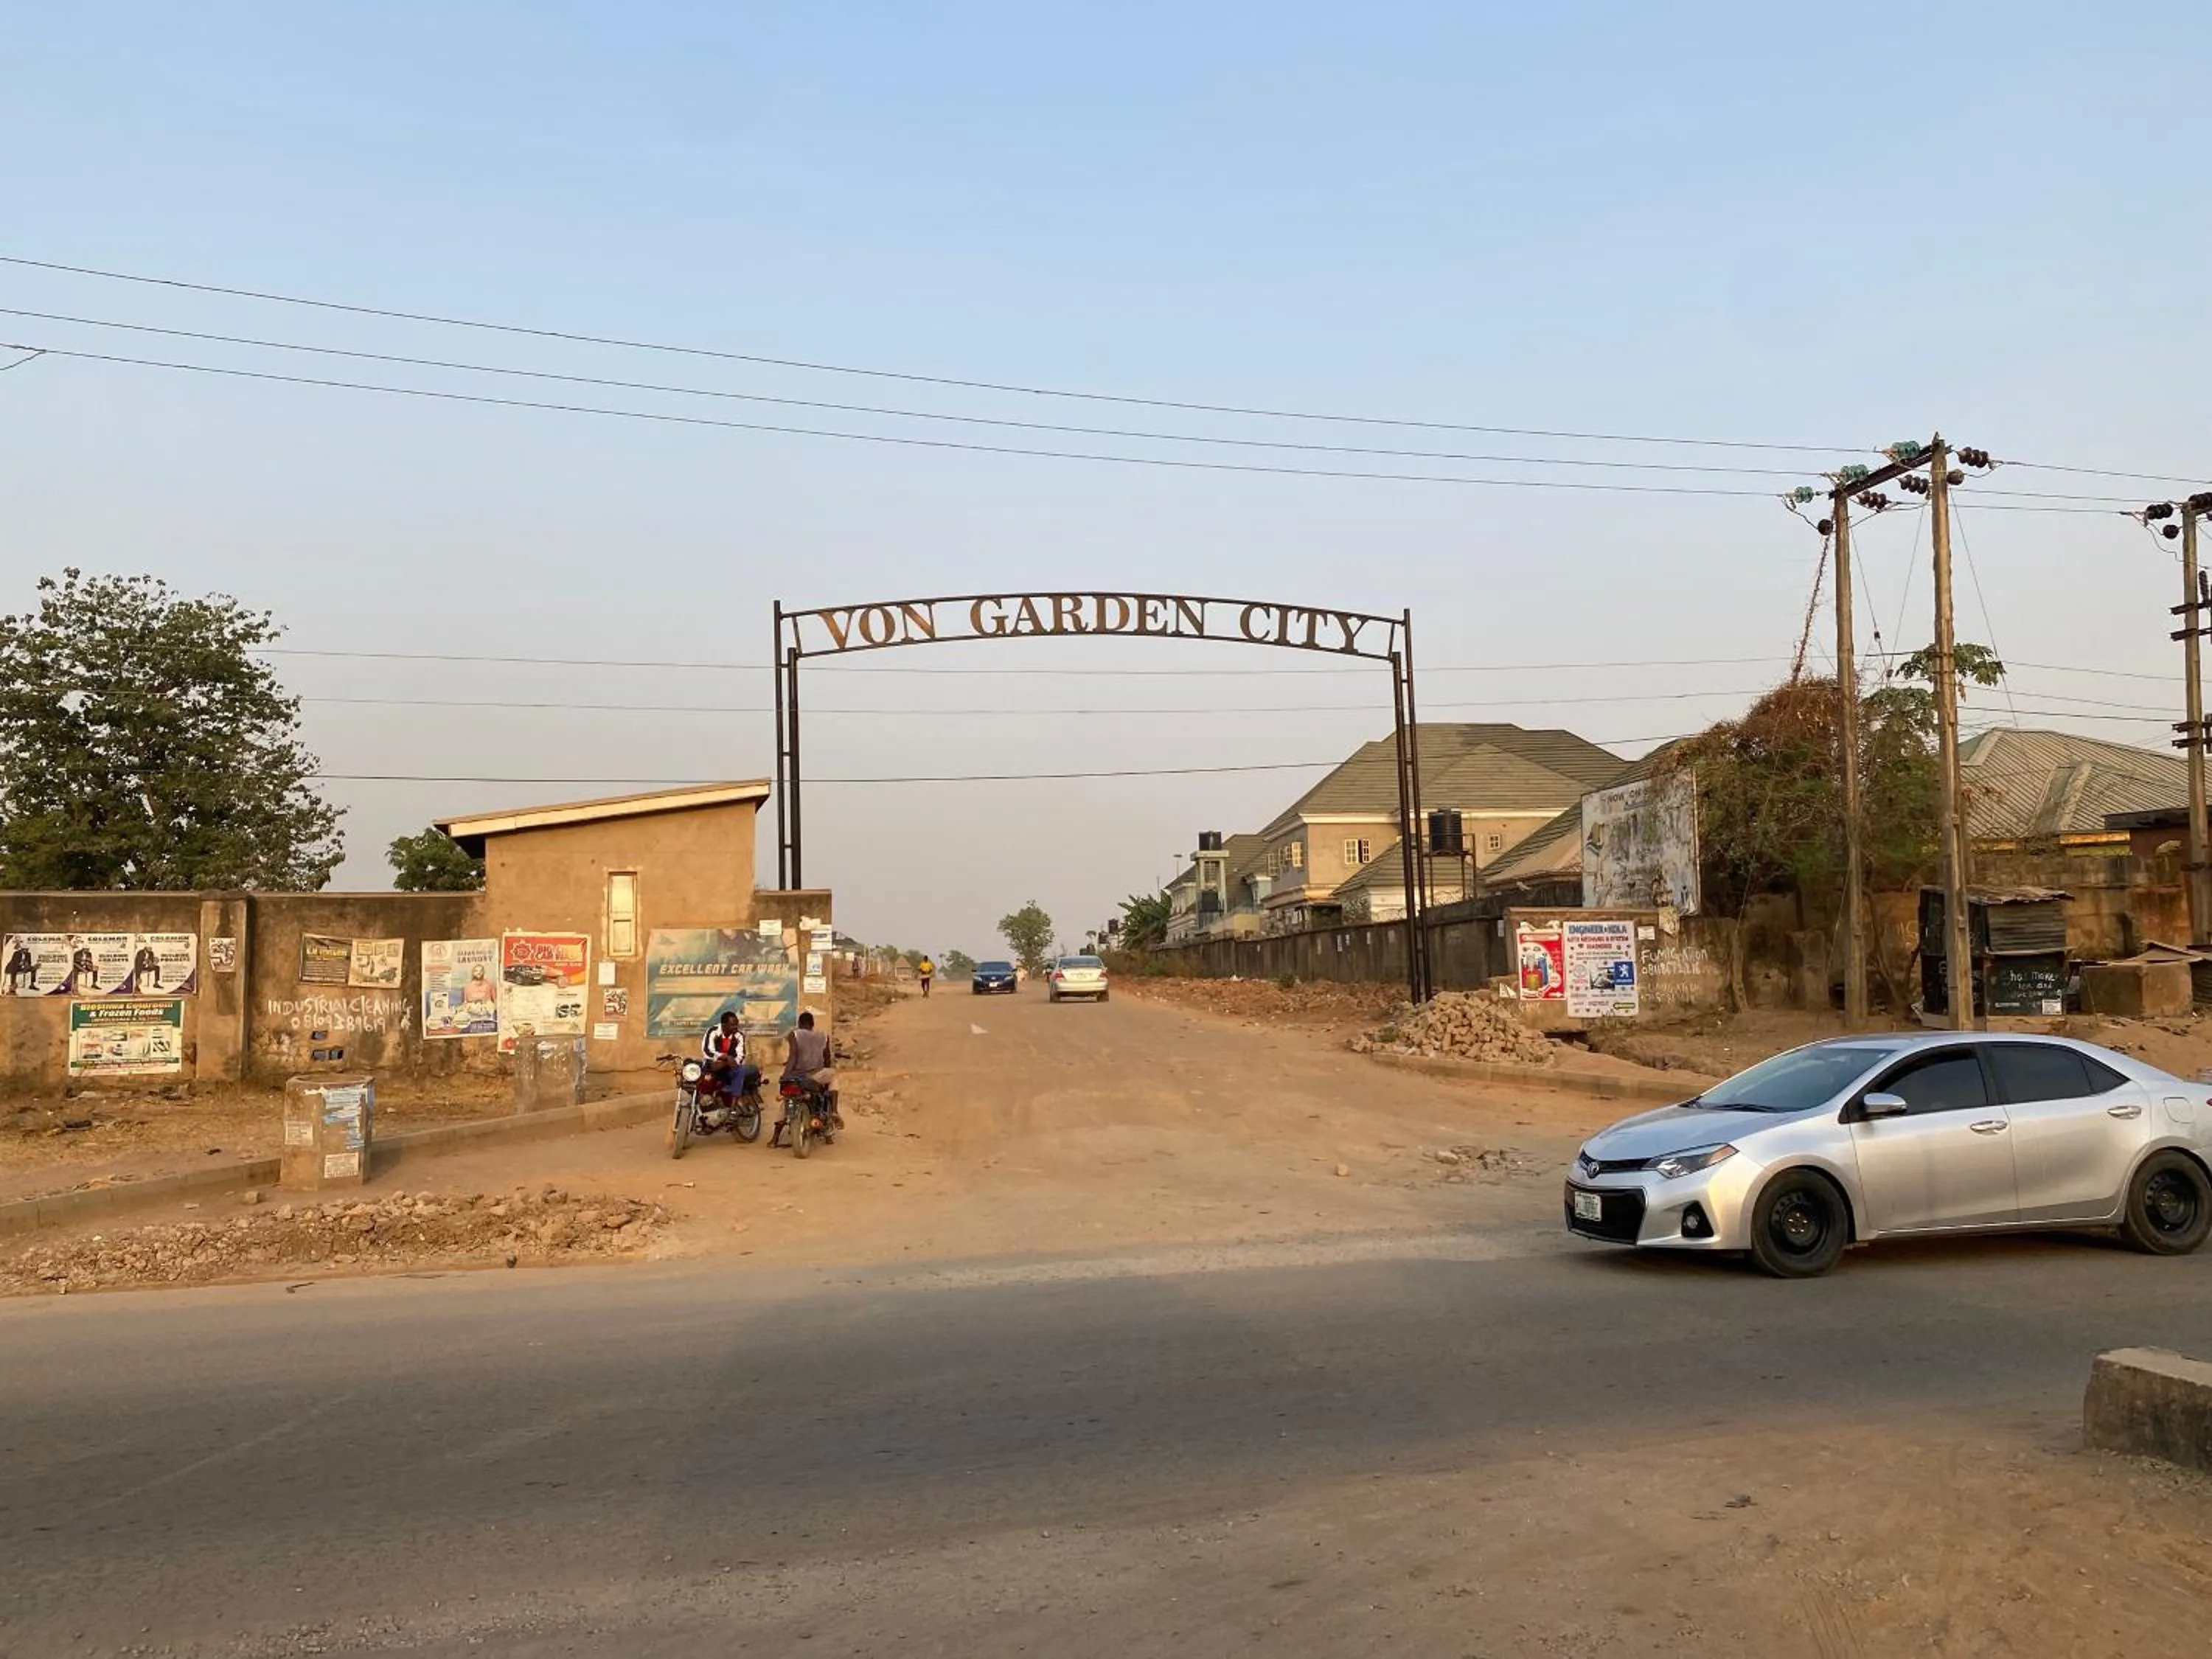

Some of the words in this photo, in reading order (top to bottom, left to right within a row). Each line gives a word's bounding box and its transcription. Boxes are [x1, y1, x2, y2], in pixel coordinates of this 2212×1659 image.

[817, 602, 936, 650] VON
[969, 594, 1206, 638] GARDEN
[1239, 603, 1370, 655] CITY
[1641, 947, 1708, 964] FUMIGATION
[659, 964, 728, 975] EXCELLENT
[731, 964, 753, 974] CAR
[268, 994, 347, 1015] INDUSTRIAL
[349, 995, 414, 1016] CLEANING
